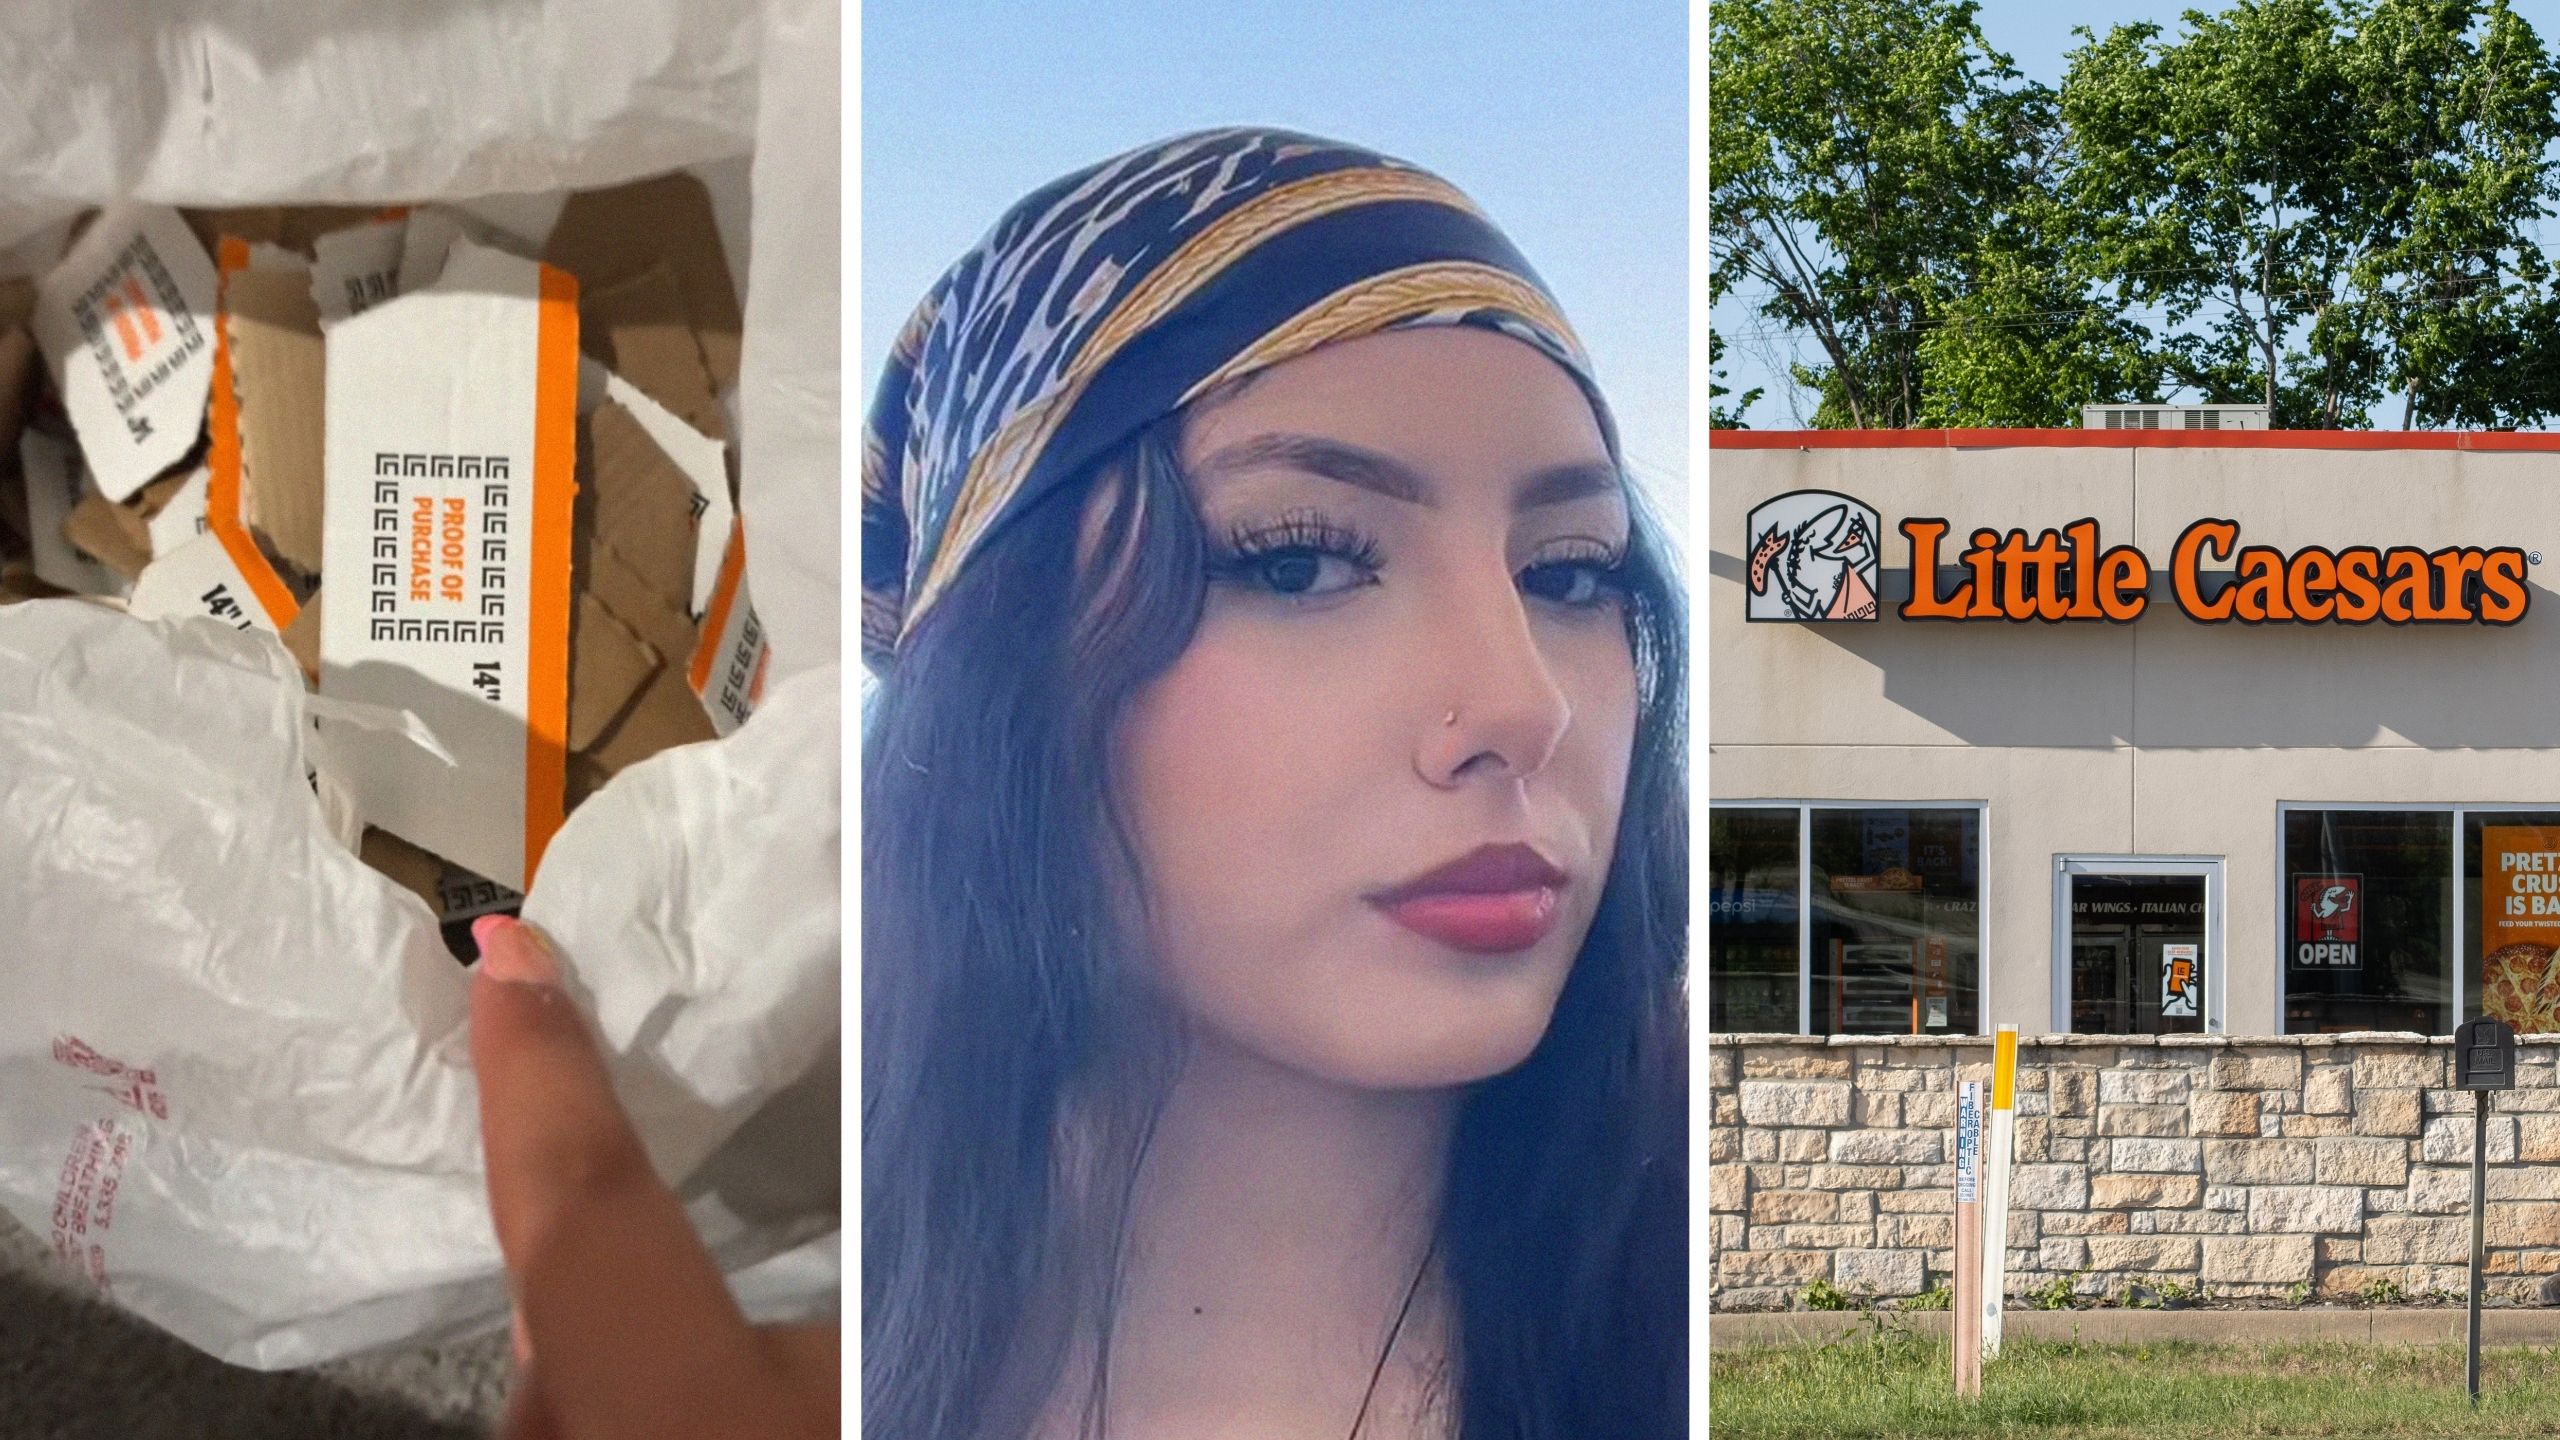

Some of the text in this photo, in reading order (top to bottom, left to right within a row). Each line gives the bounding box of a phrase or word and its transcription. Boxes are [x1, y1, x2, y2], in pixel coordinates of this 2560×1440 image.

[410, 496, 433, 602] PURCHASE
[441, 497, 465, 603] PROOF OF
[1900, 517, 2531, 625] Little Caesars
[472, 661, 501, 701] 14"
[2501, 851, 2560, 872] PRET
[2512, 873, 2560, 894] CRU
[1710, 899, 1756, 917] pepsi
[2091, 902, 2131, 913] WINGS
[2141, 902, 2186, 913] ITALIAN
[2505, 895, 2527, 916] IS
[2498, 920, 2514, 928] FEED
[2515, 920, 2533, 928] YOUR
[2298, 942, 2356, 965] OPEN
[1958, 1096, 1968, 1169] WARNING
